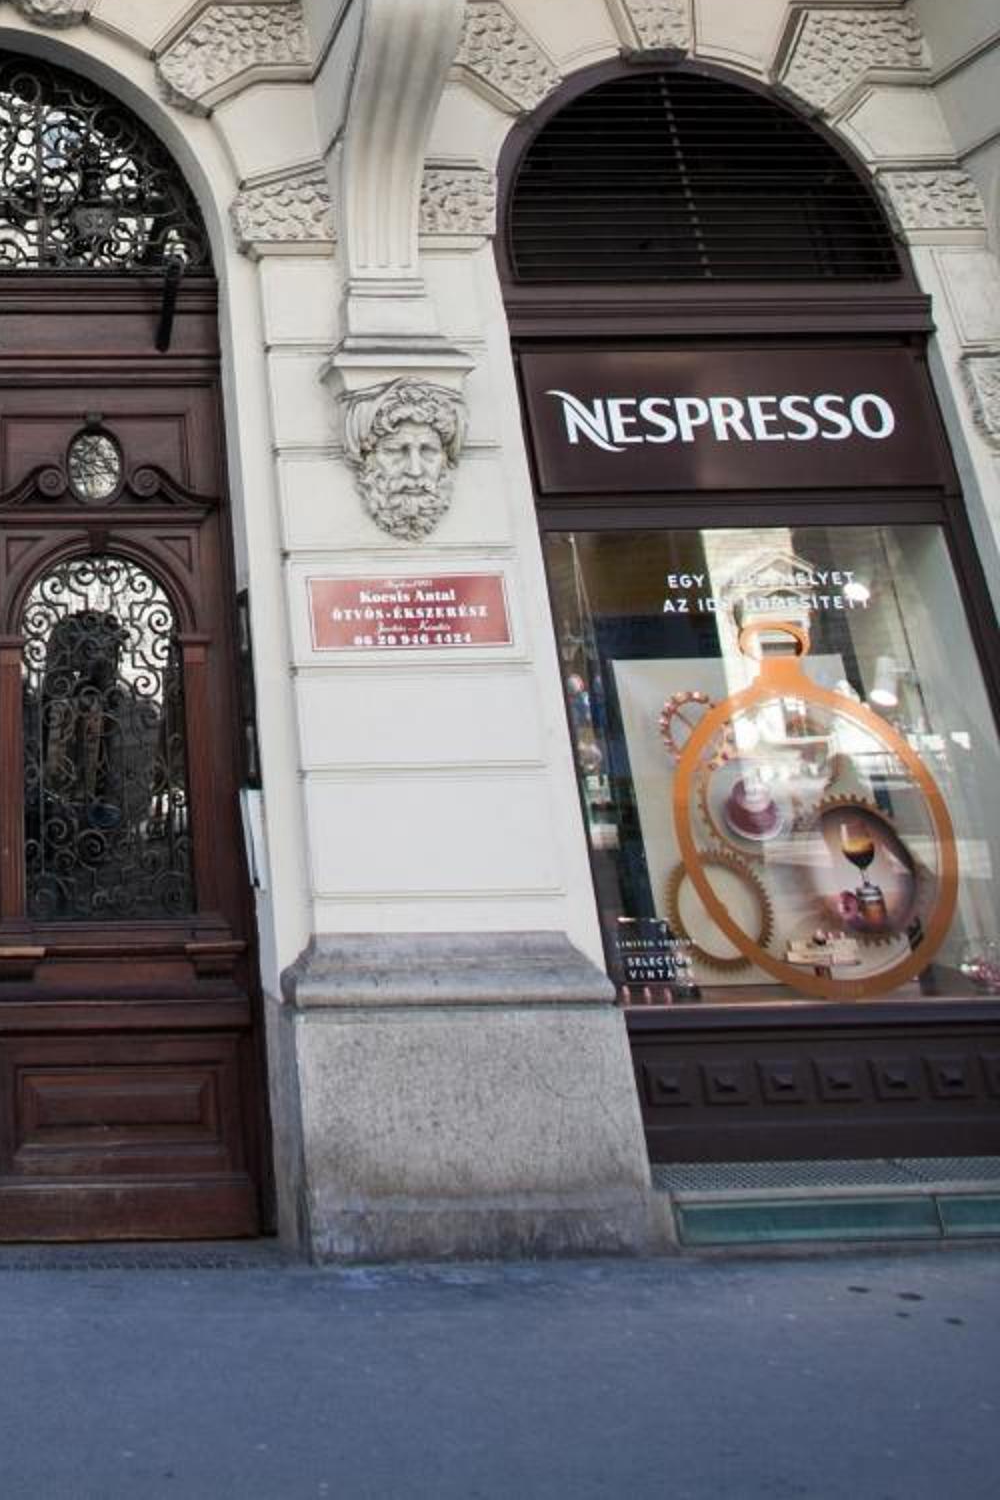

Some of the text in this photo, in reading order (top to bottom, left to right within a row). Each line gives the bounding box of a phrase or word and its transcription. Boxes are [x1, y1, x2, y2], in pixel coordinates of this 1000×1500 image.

[544, 389, 896, 452] NESPRESSO
[667, 573, 704, 589] EGY
[360, 588, 456, 603] Kocsis Antal
[663, 598, 690, 613] AZ
